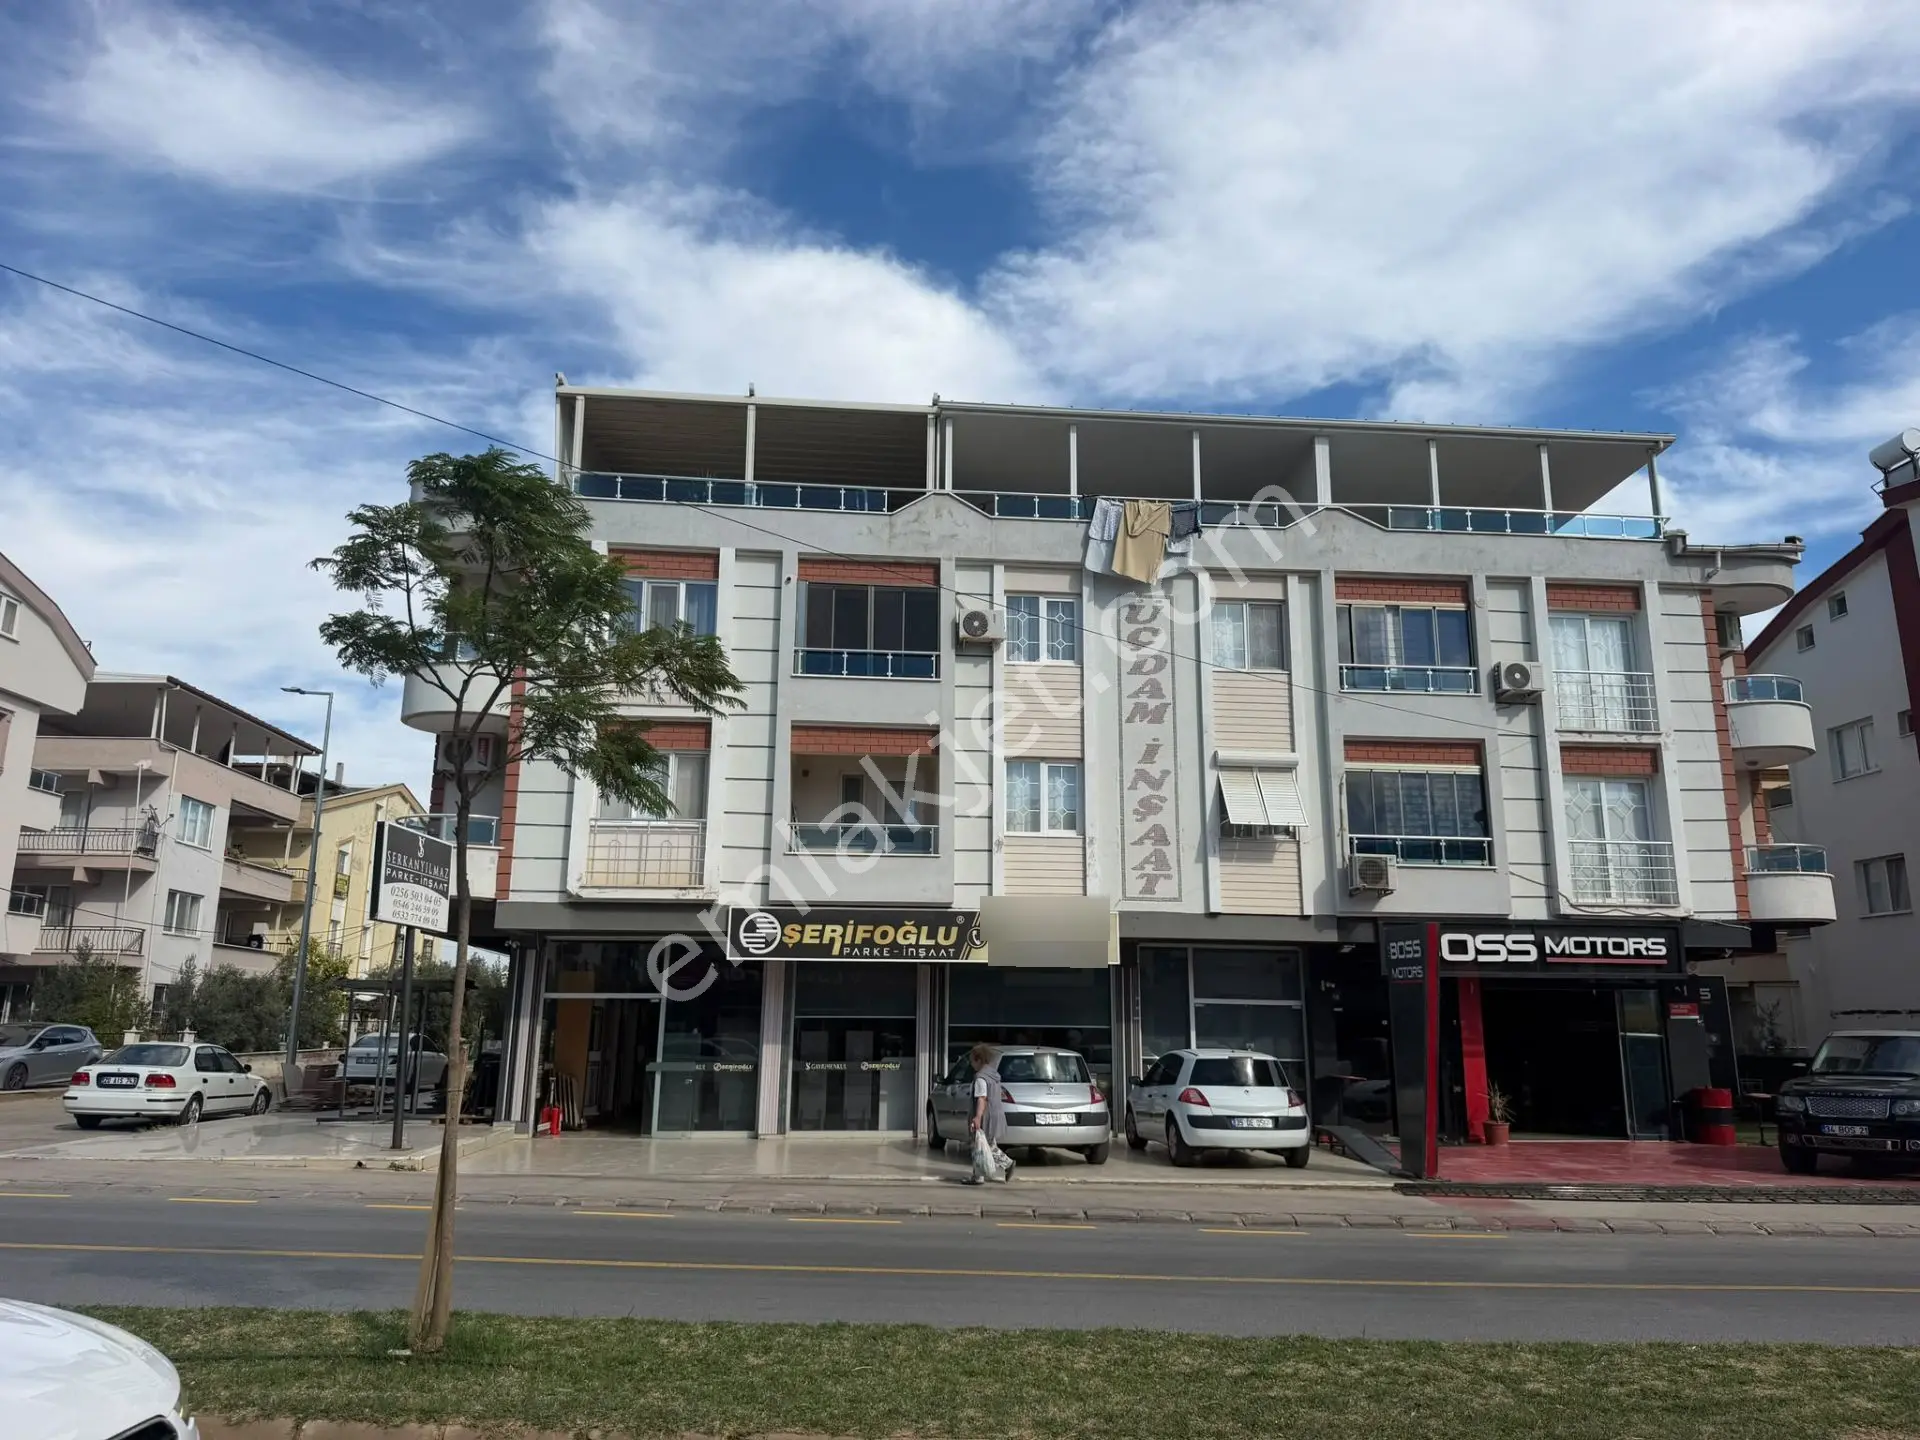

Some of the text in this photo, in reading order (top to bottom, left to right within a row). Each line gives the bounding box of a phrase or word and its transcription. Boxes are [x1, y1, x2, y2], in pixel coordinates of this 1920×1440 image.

[1127, 738, 1173, 895] İNŞAAT
[782, 919, 959, 956] ŞERİFOĞLU
[1388, 939, 1421, 960] BOSS
[1439, 933, 1668, 963] OSS MOTORS
[1391, 966, 1424, 979] MOTORS
